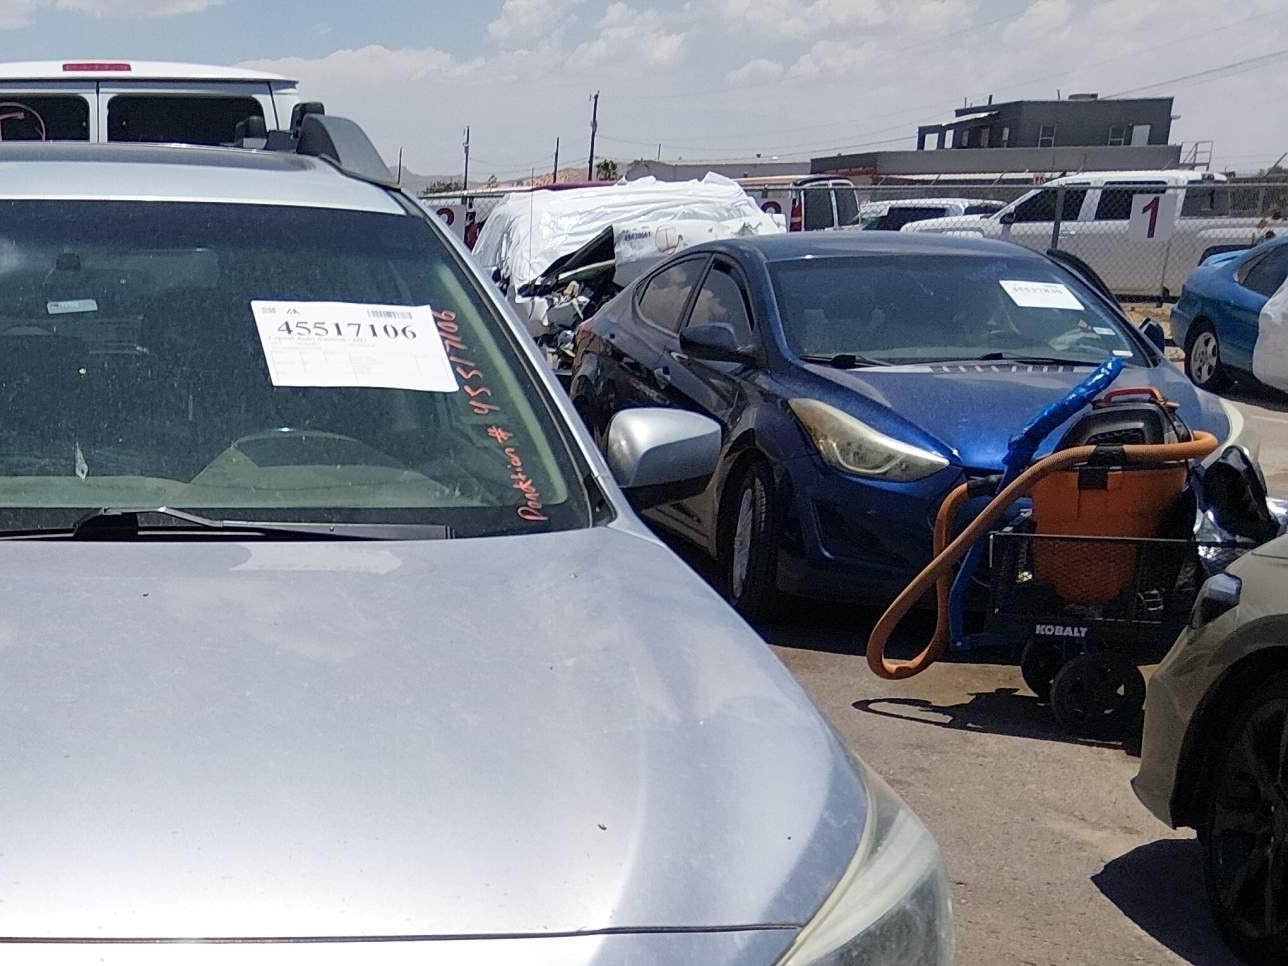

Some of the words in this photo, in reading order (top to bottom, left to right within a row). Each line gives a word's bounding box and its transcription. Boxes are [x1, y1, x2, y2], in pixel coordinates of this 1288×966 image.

[1142, 196, 1160, 238] 1
[277, 310, 417, 340] 45517106
[1035, 624, 1088, 637] KOBALT
